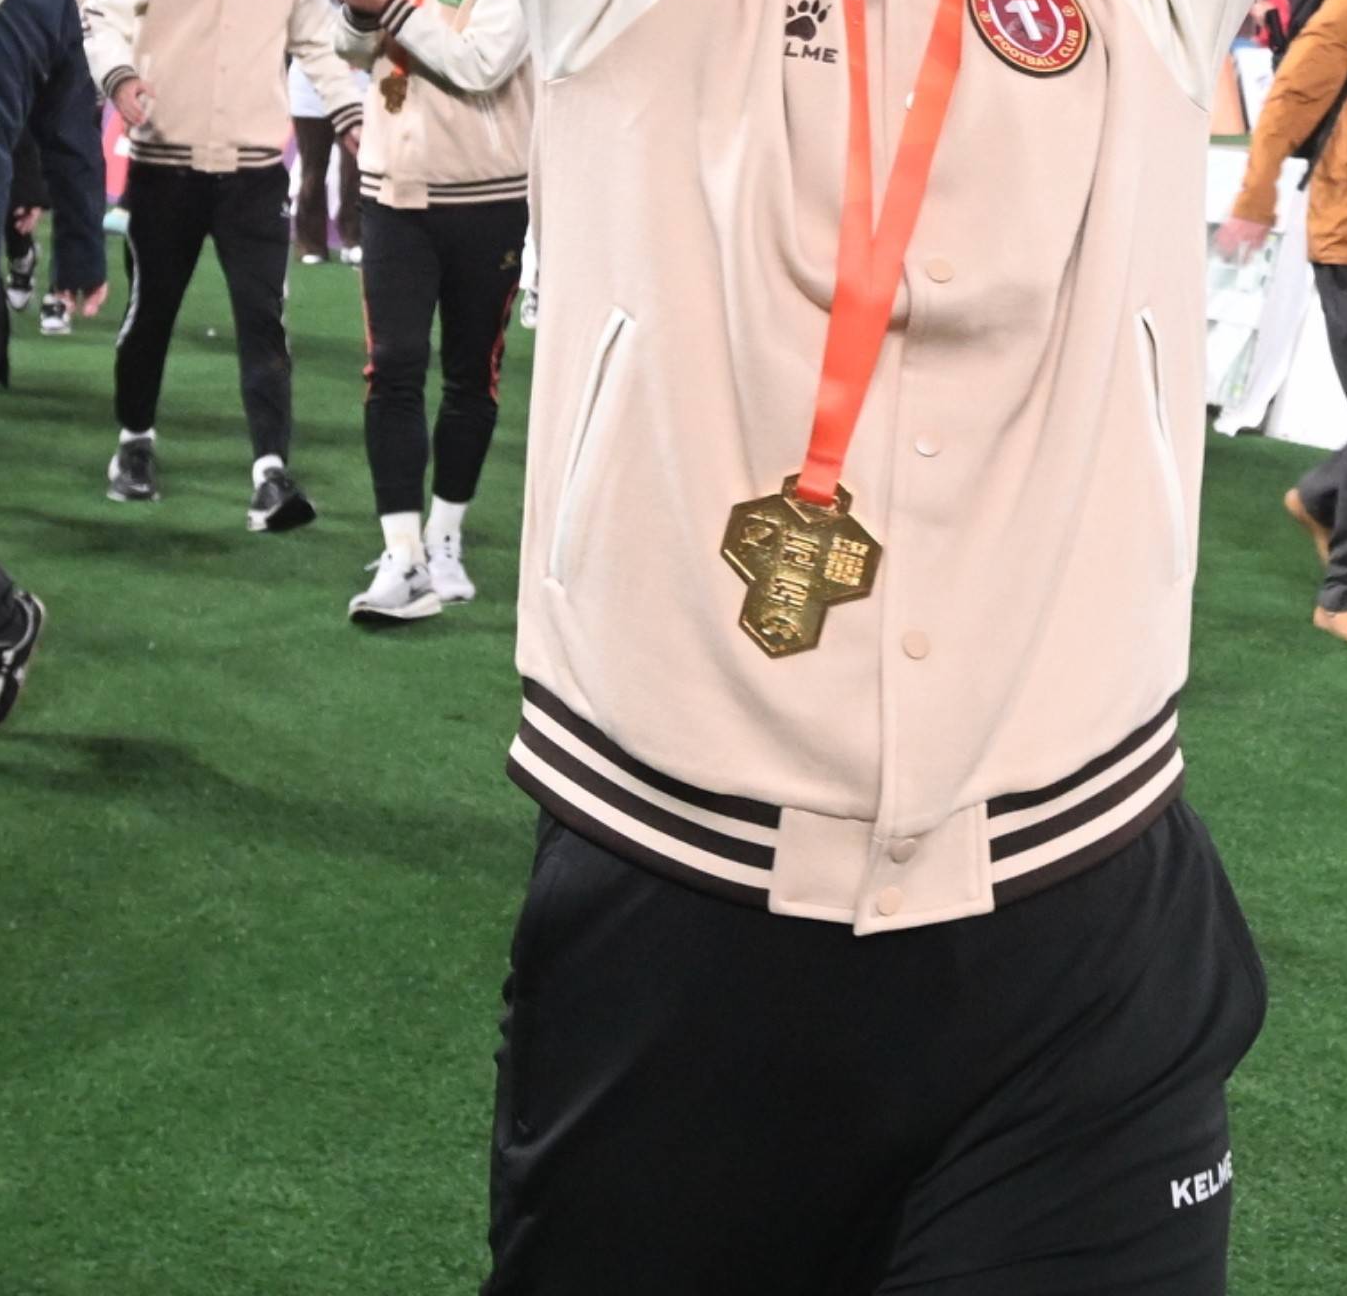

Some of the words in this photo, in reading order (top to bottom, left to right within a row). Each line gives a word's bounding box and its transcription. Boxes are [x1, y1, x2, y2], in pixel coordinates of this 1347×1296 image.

[783, 41, 839, 64] LME
[992, 34, 1060, 67] FOOTBALL
[1058, 29, 1080, 57] CLUB
